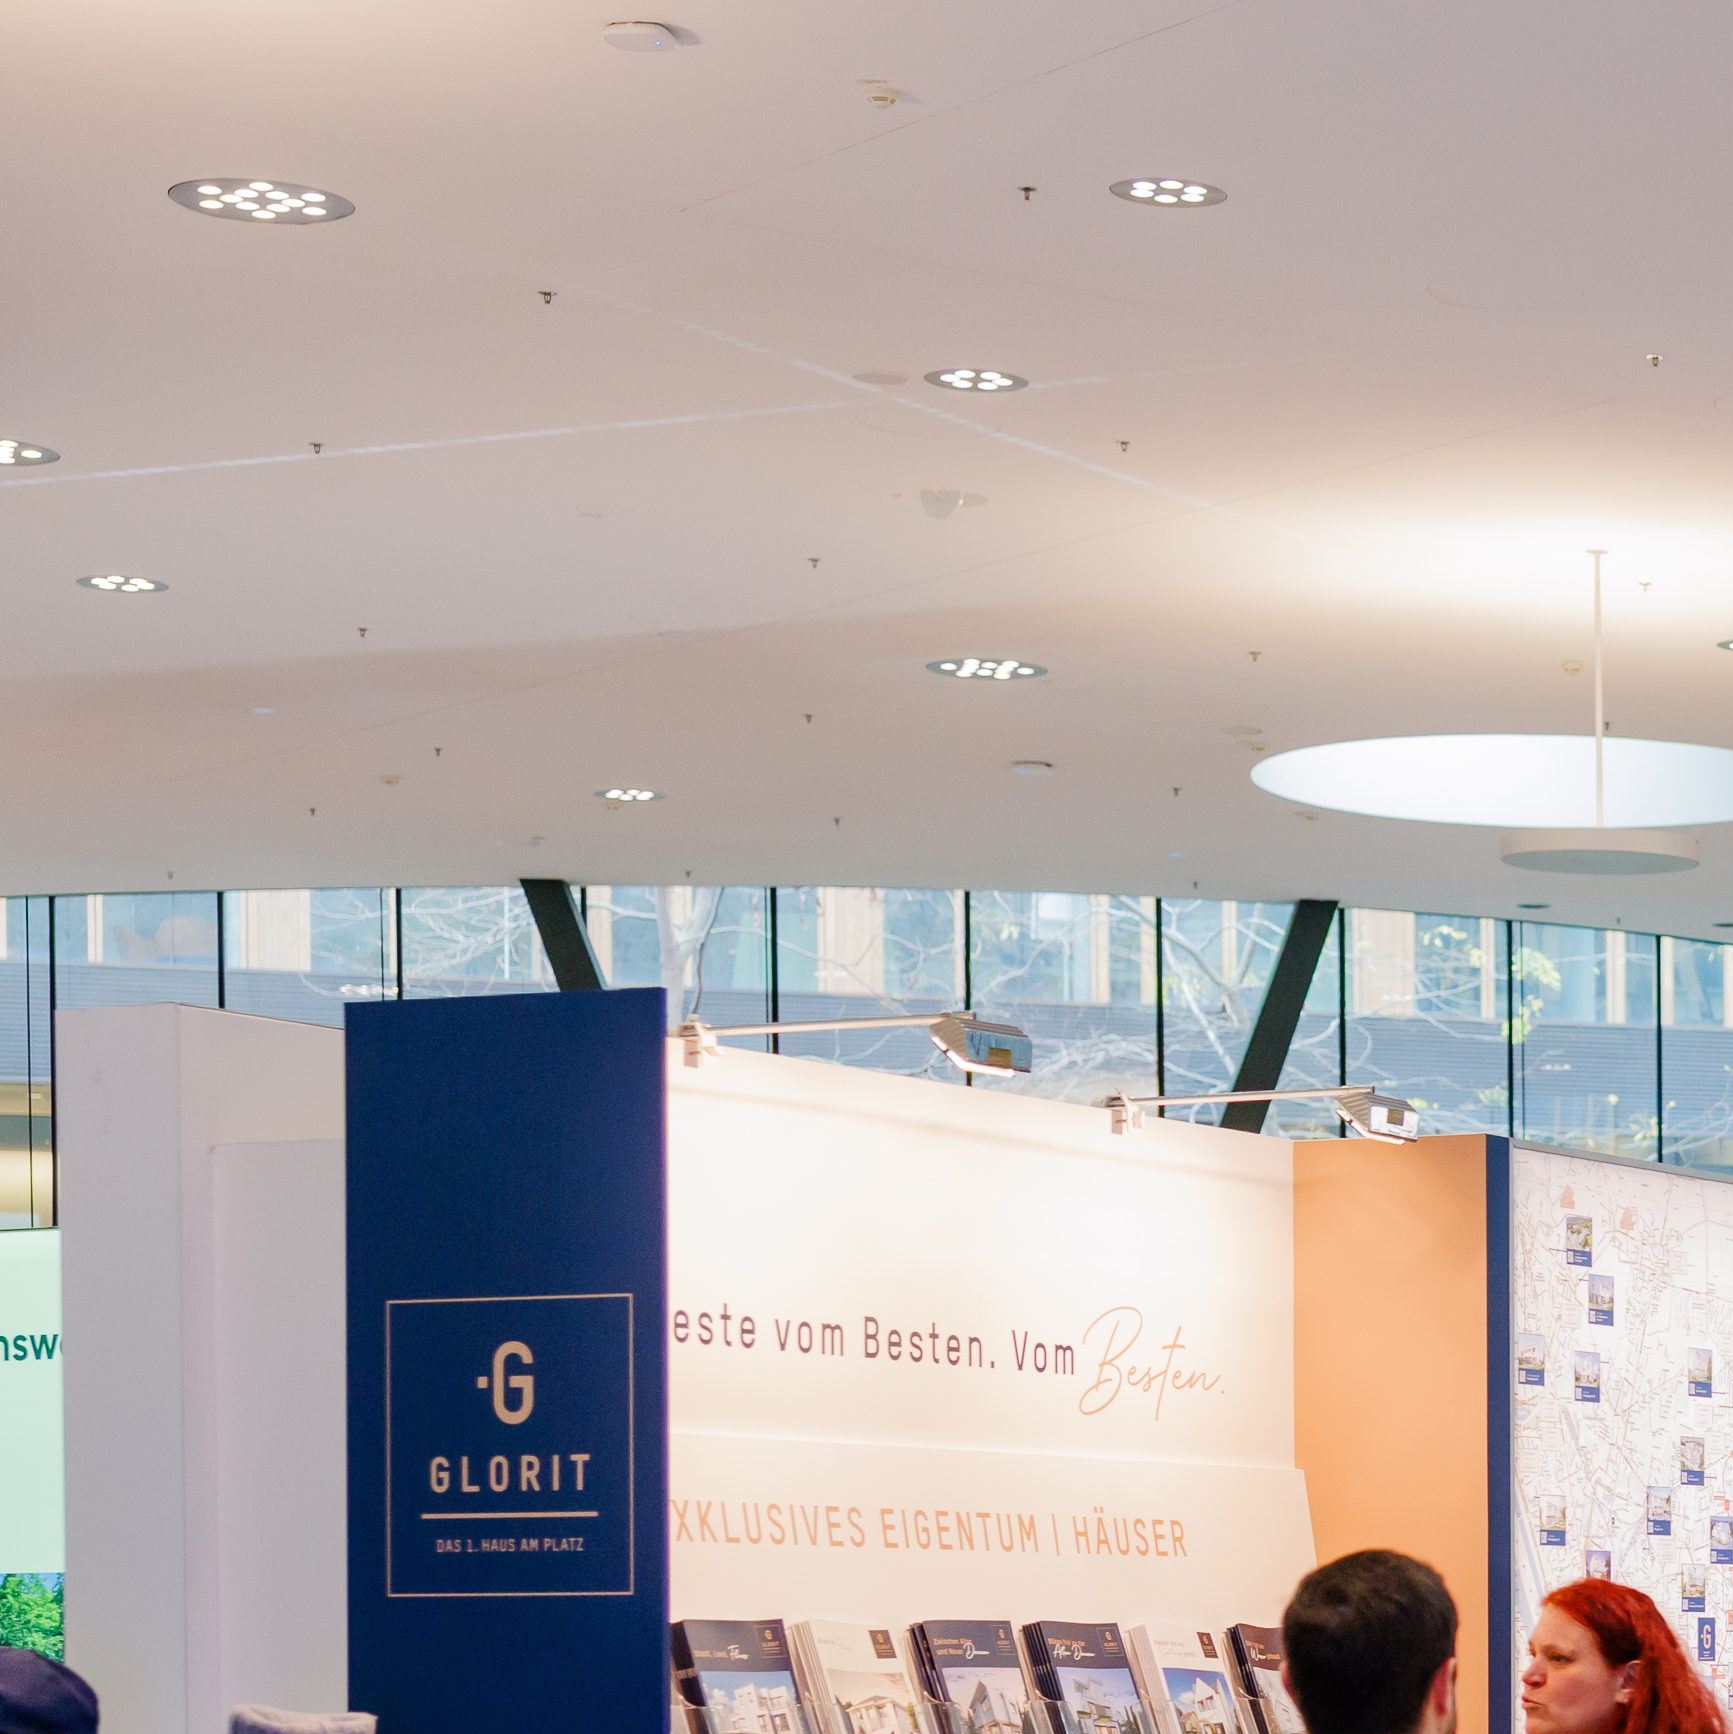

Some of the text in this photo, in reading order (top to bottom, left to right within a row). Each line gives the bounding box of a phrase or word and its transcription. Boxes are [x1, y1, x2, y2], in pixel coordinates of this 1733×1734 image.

[673, 1303, 1225, 1421] este vom Besten. Vom Besten.
[430, 1454, 591, 1494] GLORIT
[436, 1539, 462, 1552] DAS
[481, 1538, 516, 1552] HAUS
[520, 1538, 539, 1552] AM
[543, 1537, 585, 1551] PLATZ
[671, 1500, 866, 1548] XKLUSIVES
[880, 1508, 1040, 1553] EIGENTUM
[1072, 1507, 1189, 1558] HÄUSER
